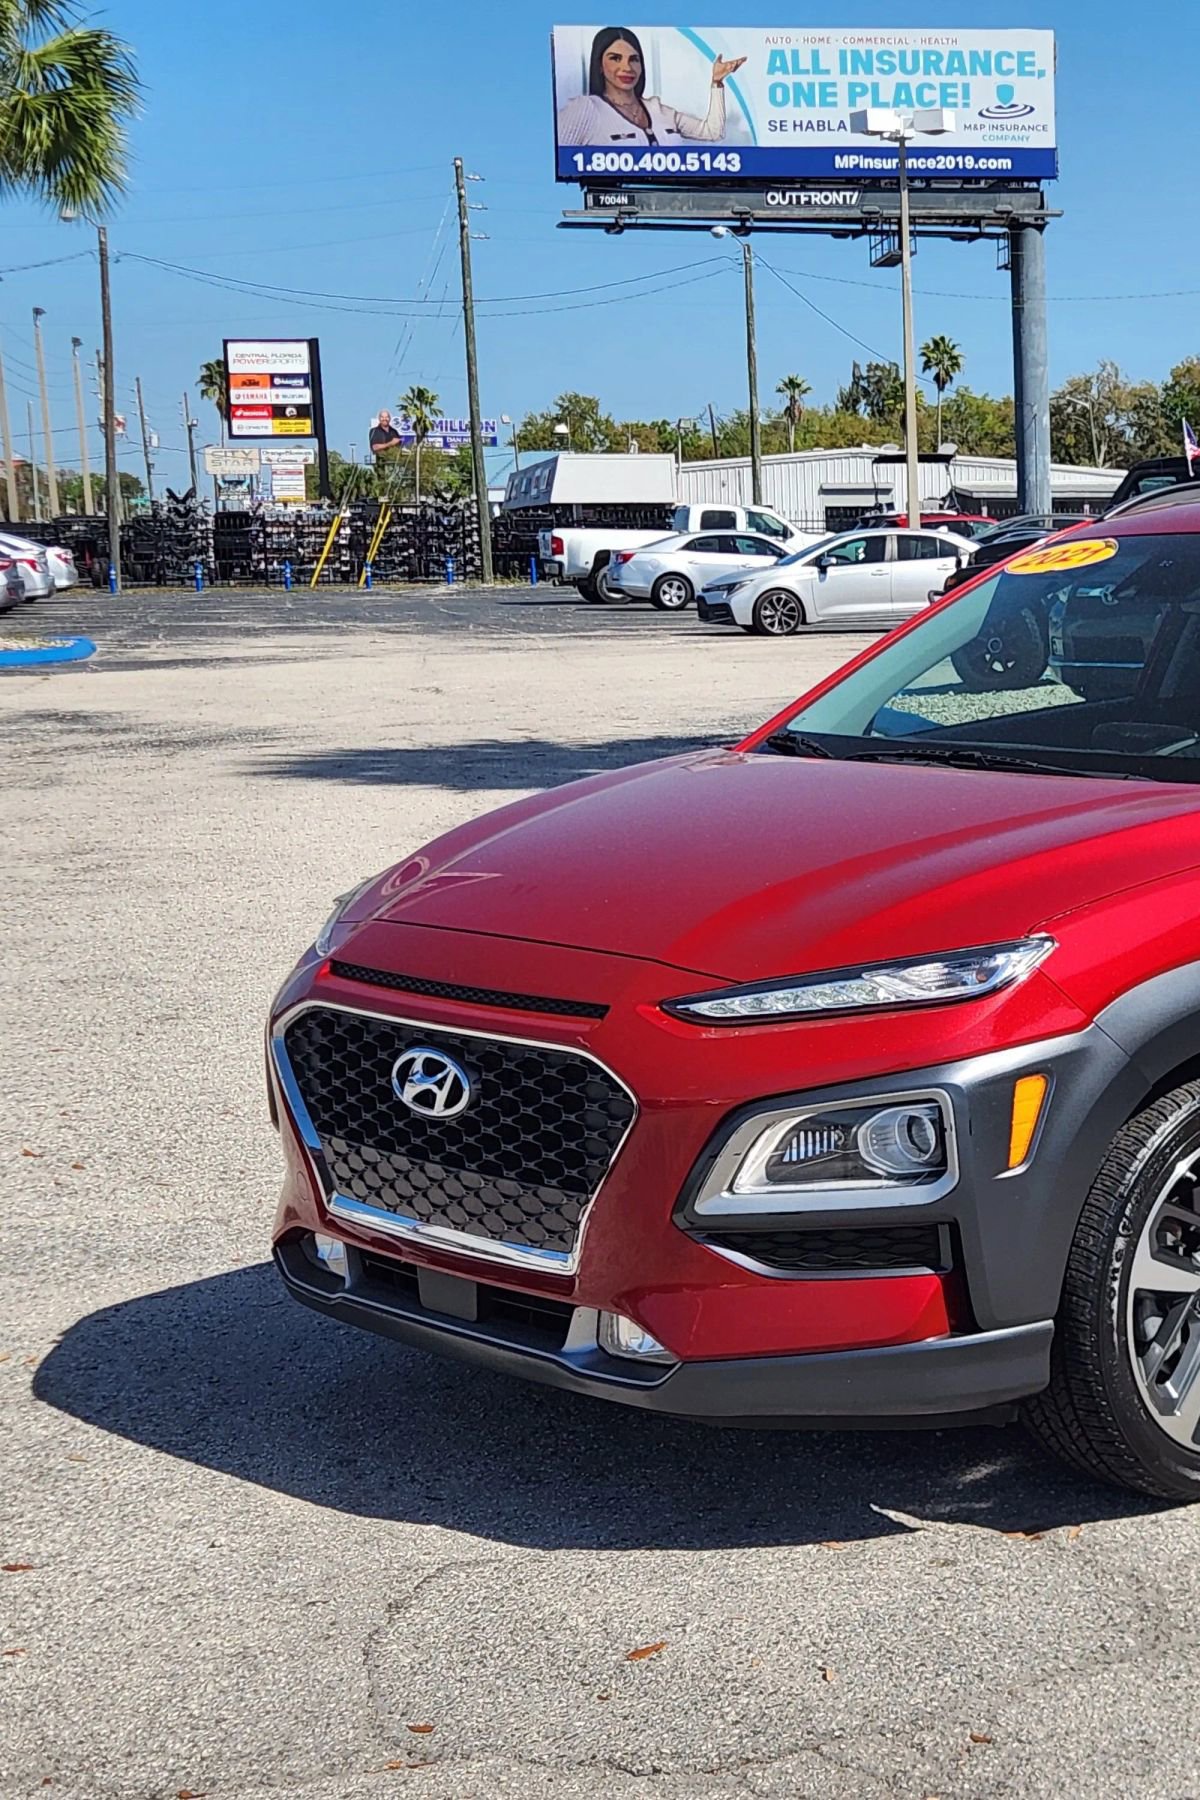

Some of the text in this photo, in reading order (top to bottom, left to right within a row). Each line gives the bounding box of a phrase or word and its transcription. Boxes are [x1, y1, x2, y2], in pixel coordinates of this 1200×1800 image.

[765, 36, 958, 46] AUTO HOME COMMERCIAL HEALTH
[766, 49, 1046, 79] ALL INSURANCE,
[768, 81, 970, 109] ONE PLACE!
[767, 120, 848, 132] SE HABLA
[963, 123, 1048, 132] M&P INSURANCE
[982, 134, 1030, 142] COMPANY
[572, 152, 742, 173] 1.800.400.5143
[598, 195, 629, 205] 7004N
[232, 358, 305, 366] POWERSPORTS
[1010, 547, 1105, 570] 2021
